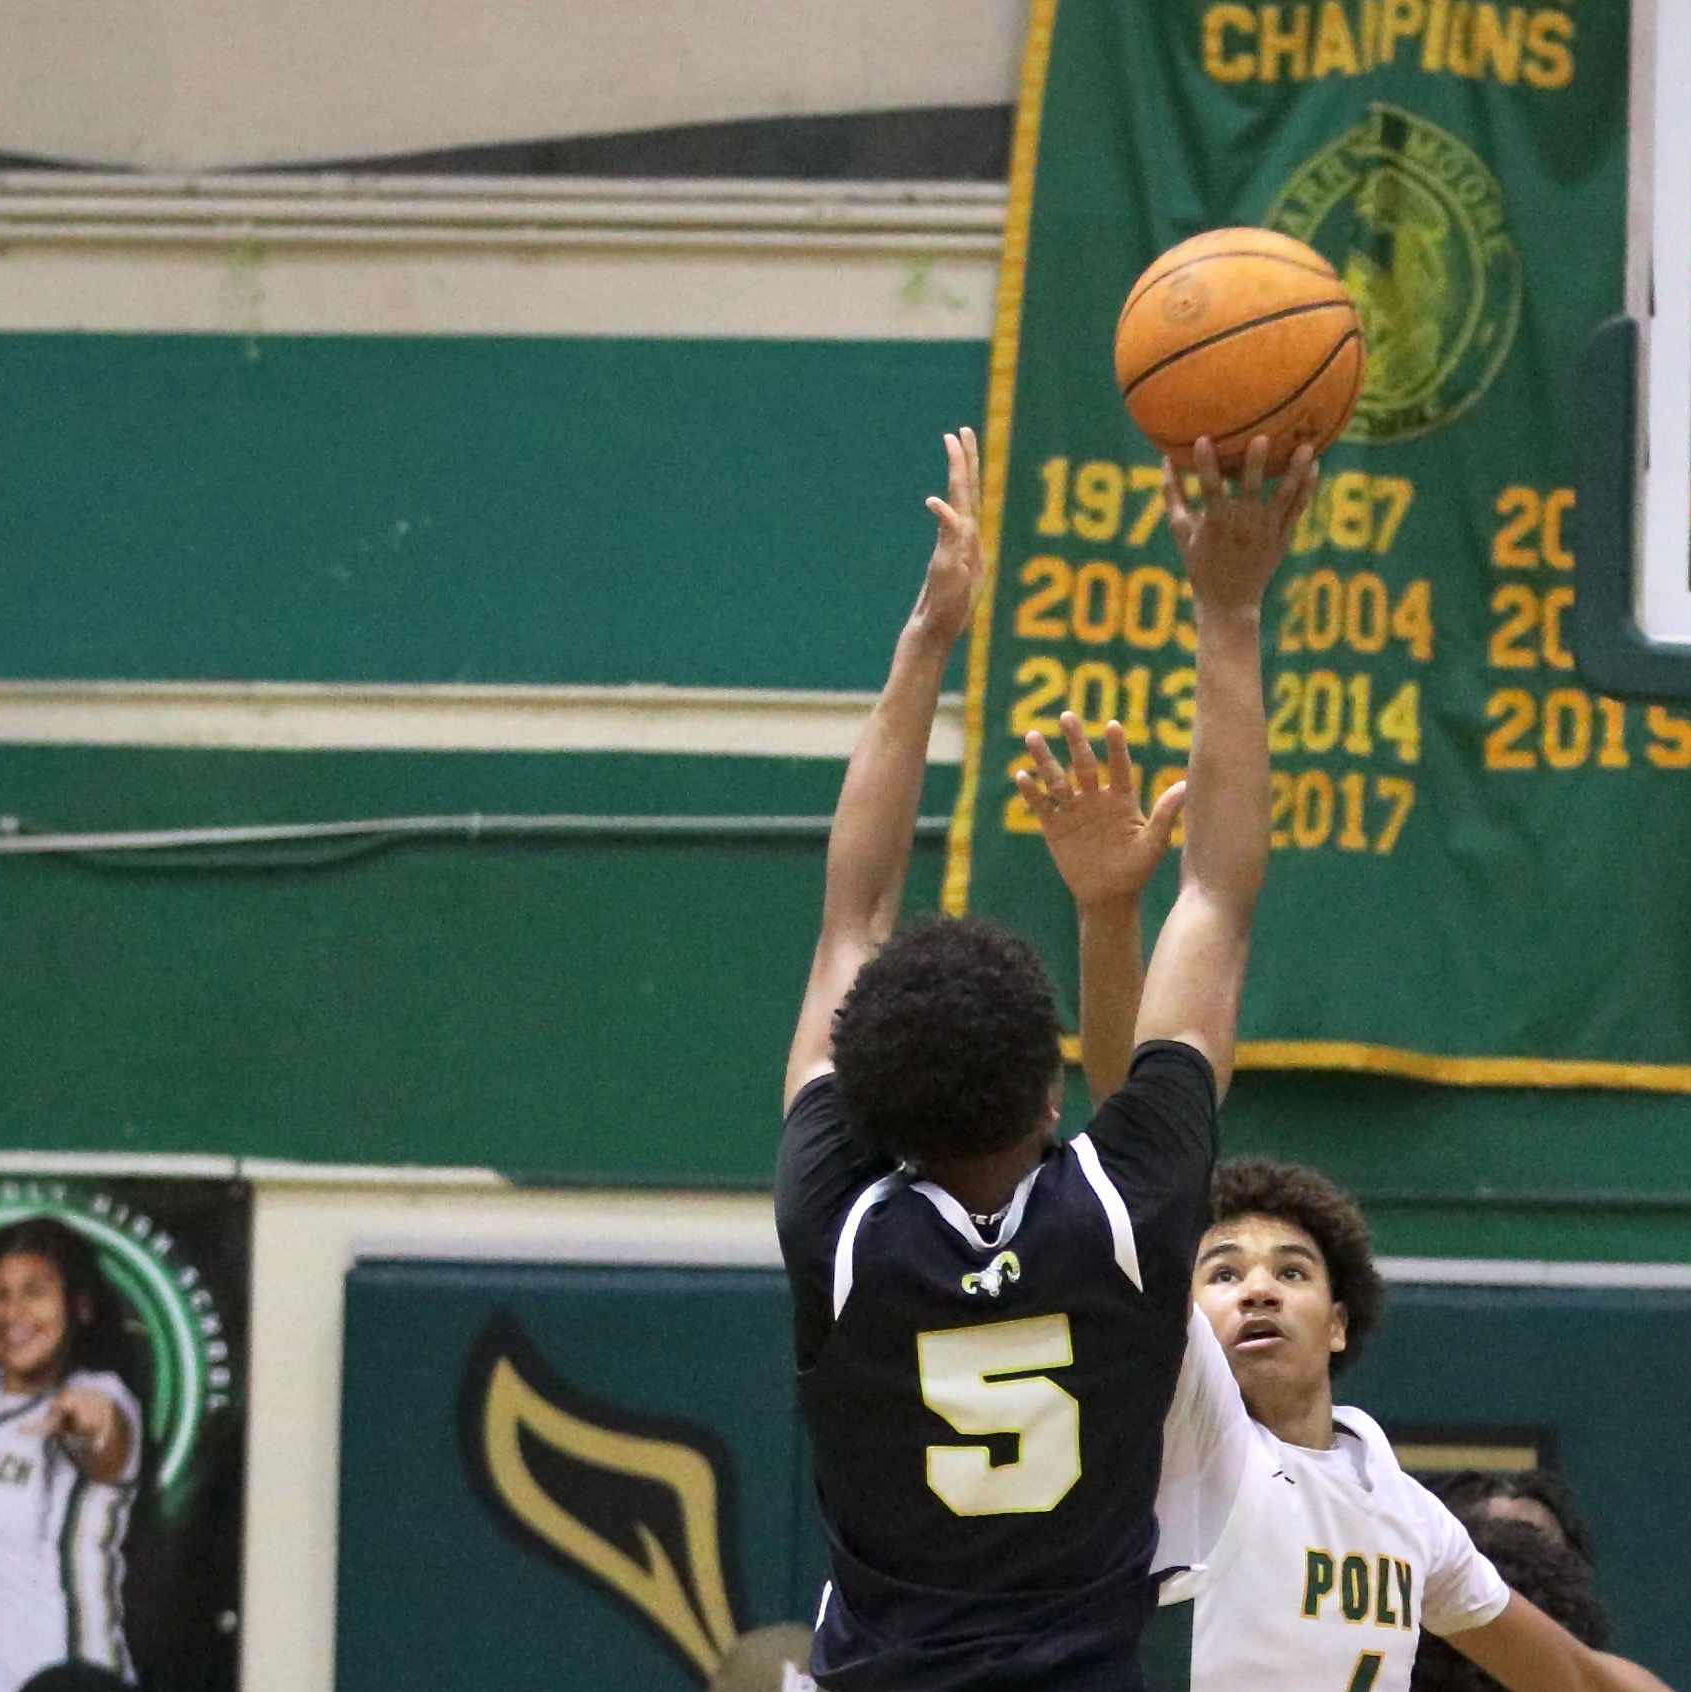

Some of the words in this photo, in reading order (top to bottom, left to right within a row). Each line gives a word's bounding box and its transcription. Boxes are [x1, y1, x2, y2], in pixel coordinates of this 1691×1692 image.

[1036, 456, 1203, 547] 197
[1278, 568, 1434, 661] 2004
[1011, 656, 1198, 749] 2013
[1269, 668, 1421, 764] 2014
[1269, 768, 1417, 854] 2017
[916, 1312, 1082, 1518] 5
[1300, 1546, 1413, 1632] POLY
